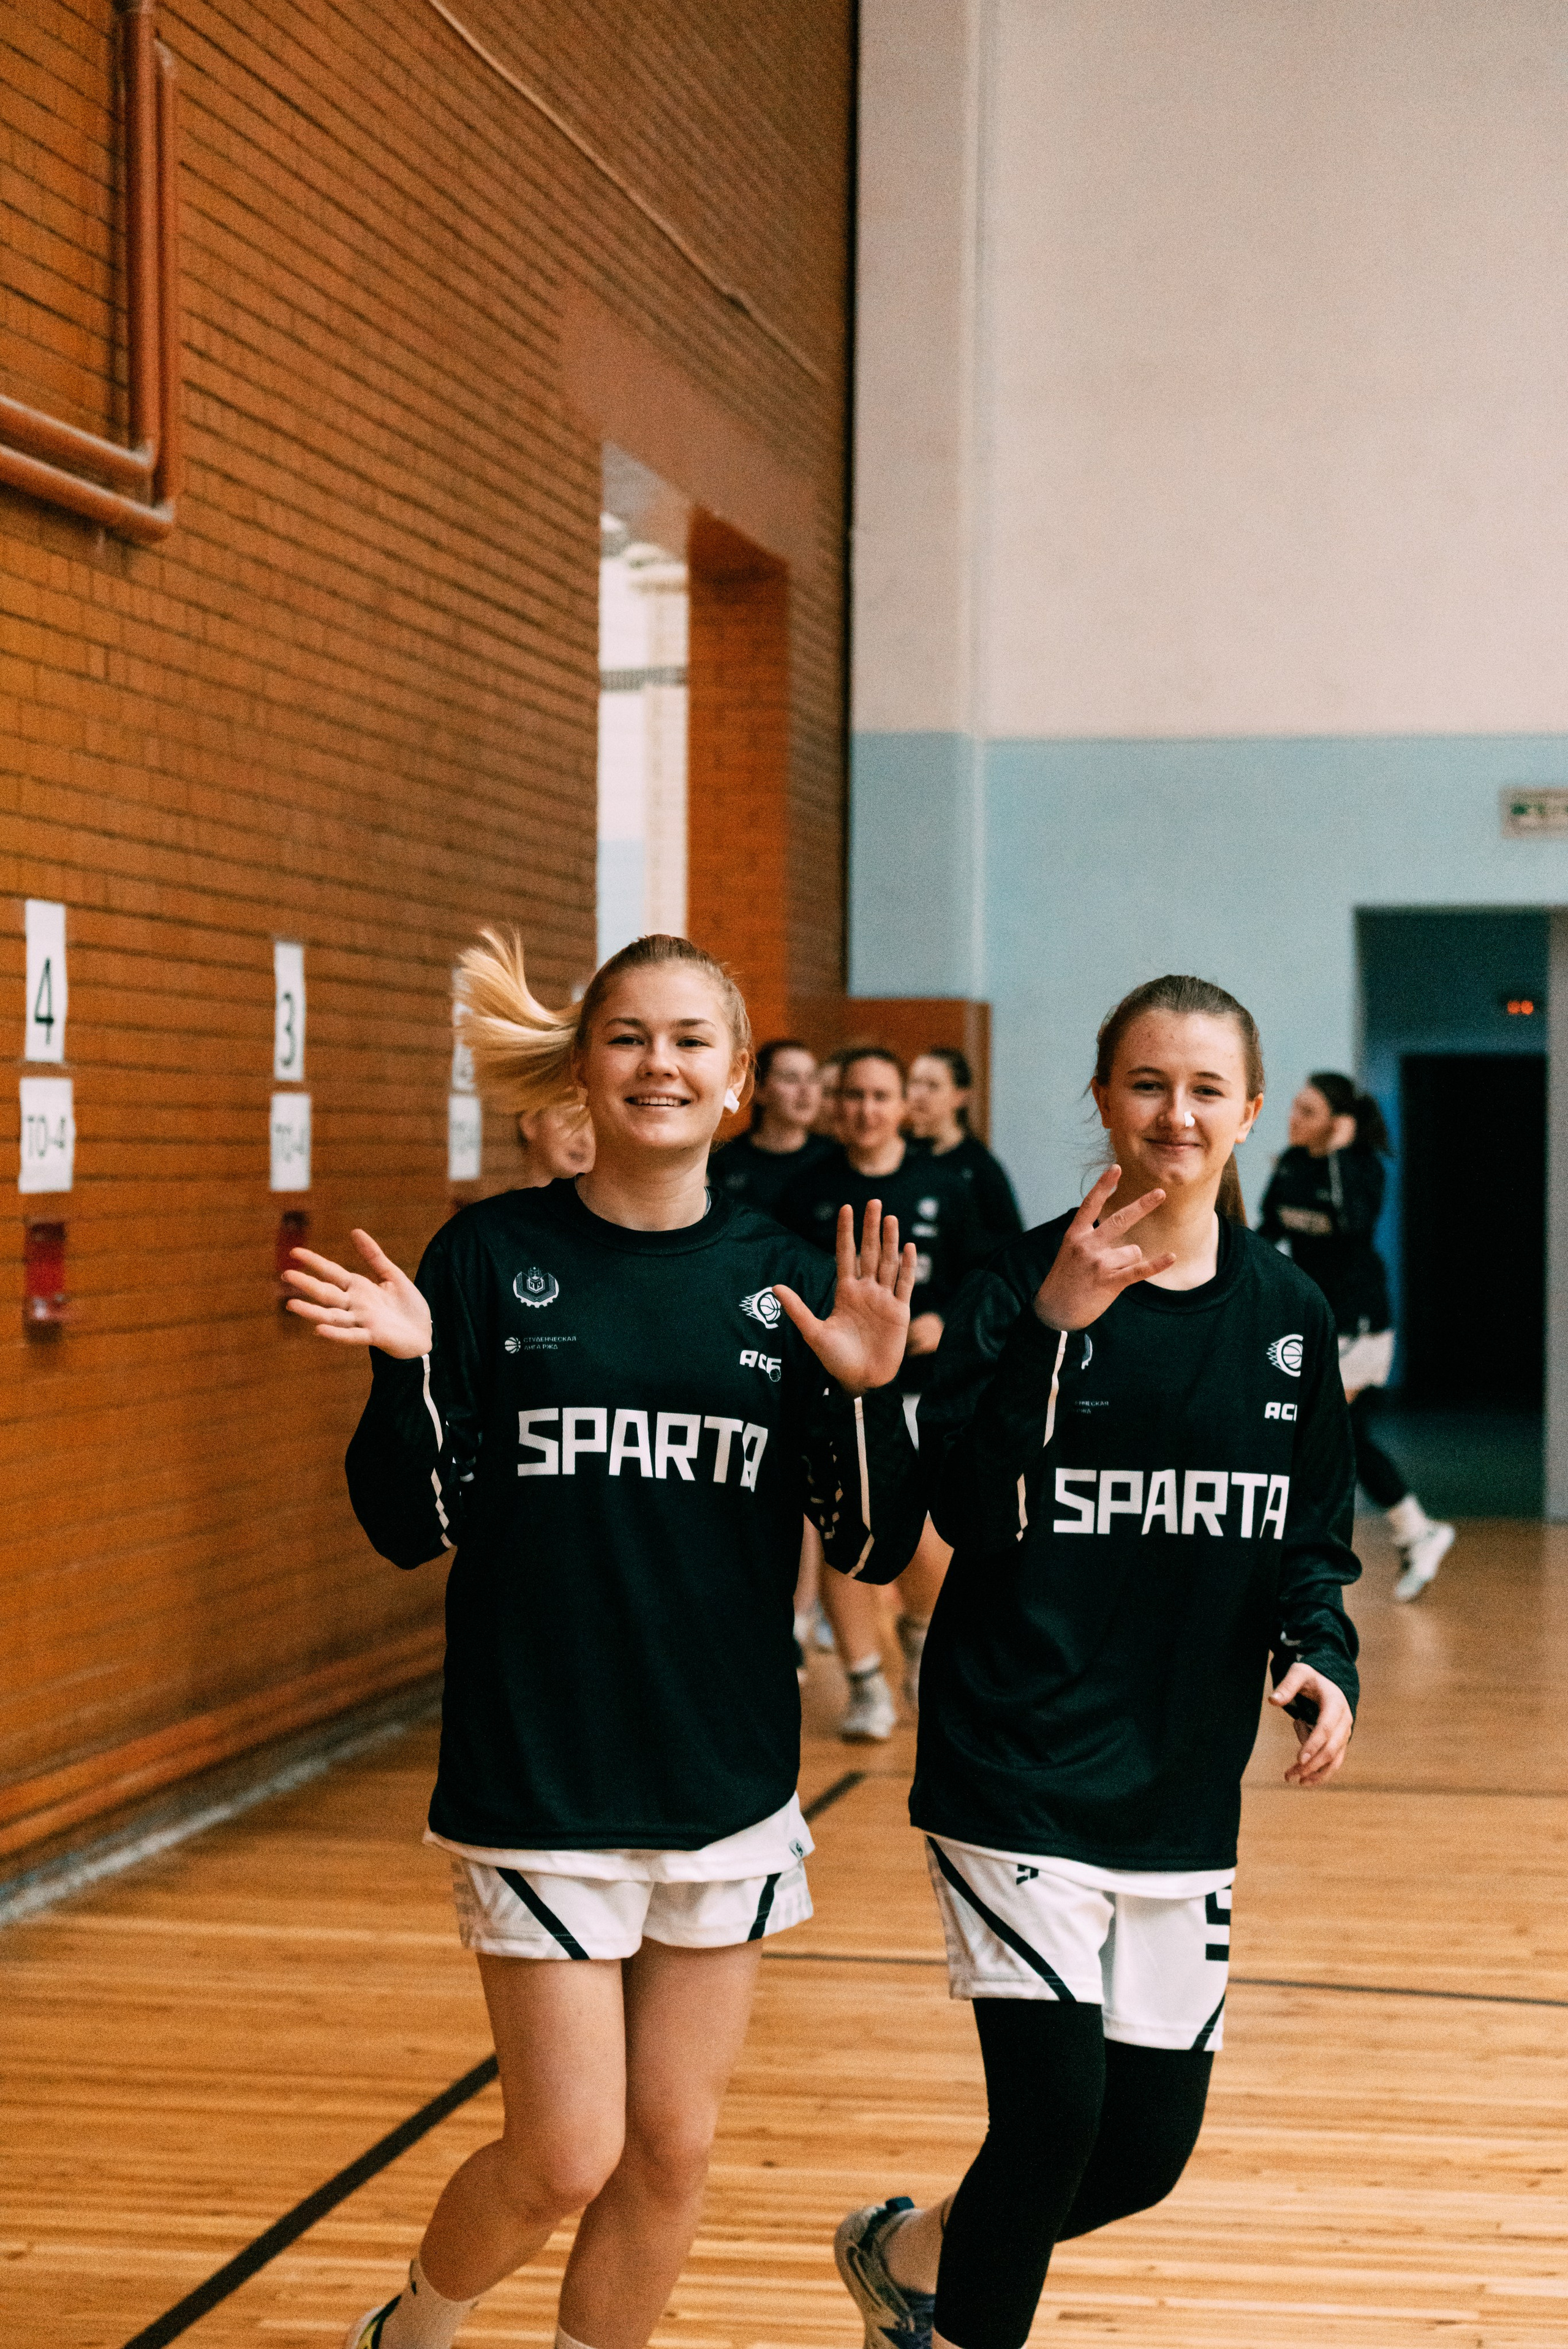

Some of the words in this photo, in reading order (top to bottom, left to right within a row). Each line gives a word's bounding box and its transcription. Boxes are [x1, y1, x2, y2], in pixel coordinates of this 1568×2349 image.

[34, 957, 55, 1045] 4
[281, 990, 296, 1069] 3
[518, 1407, 768, 1493] SPARTA
[1264, 1402, 1298, 1422] АС
[1053, 1468, 1290, 1540] SPARTA
